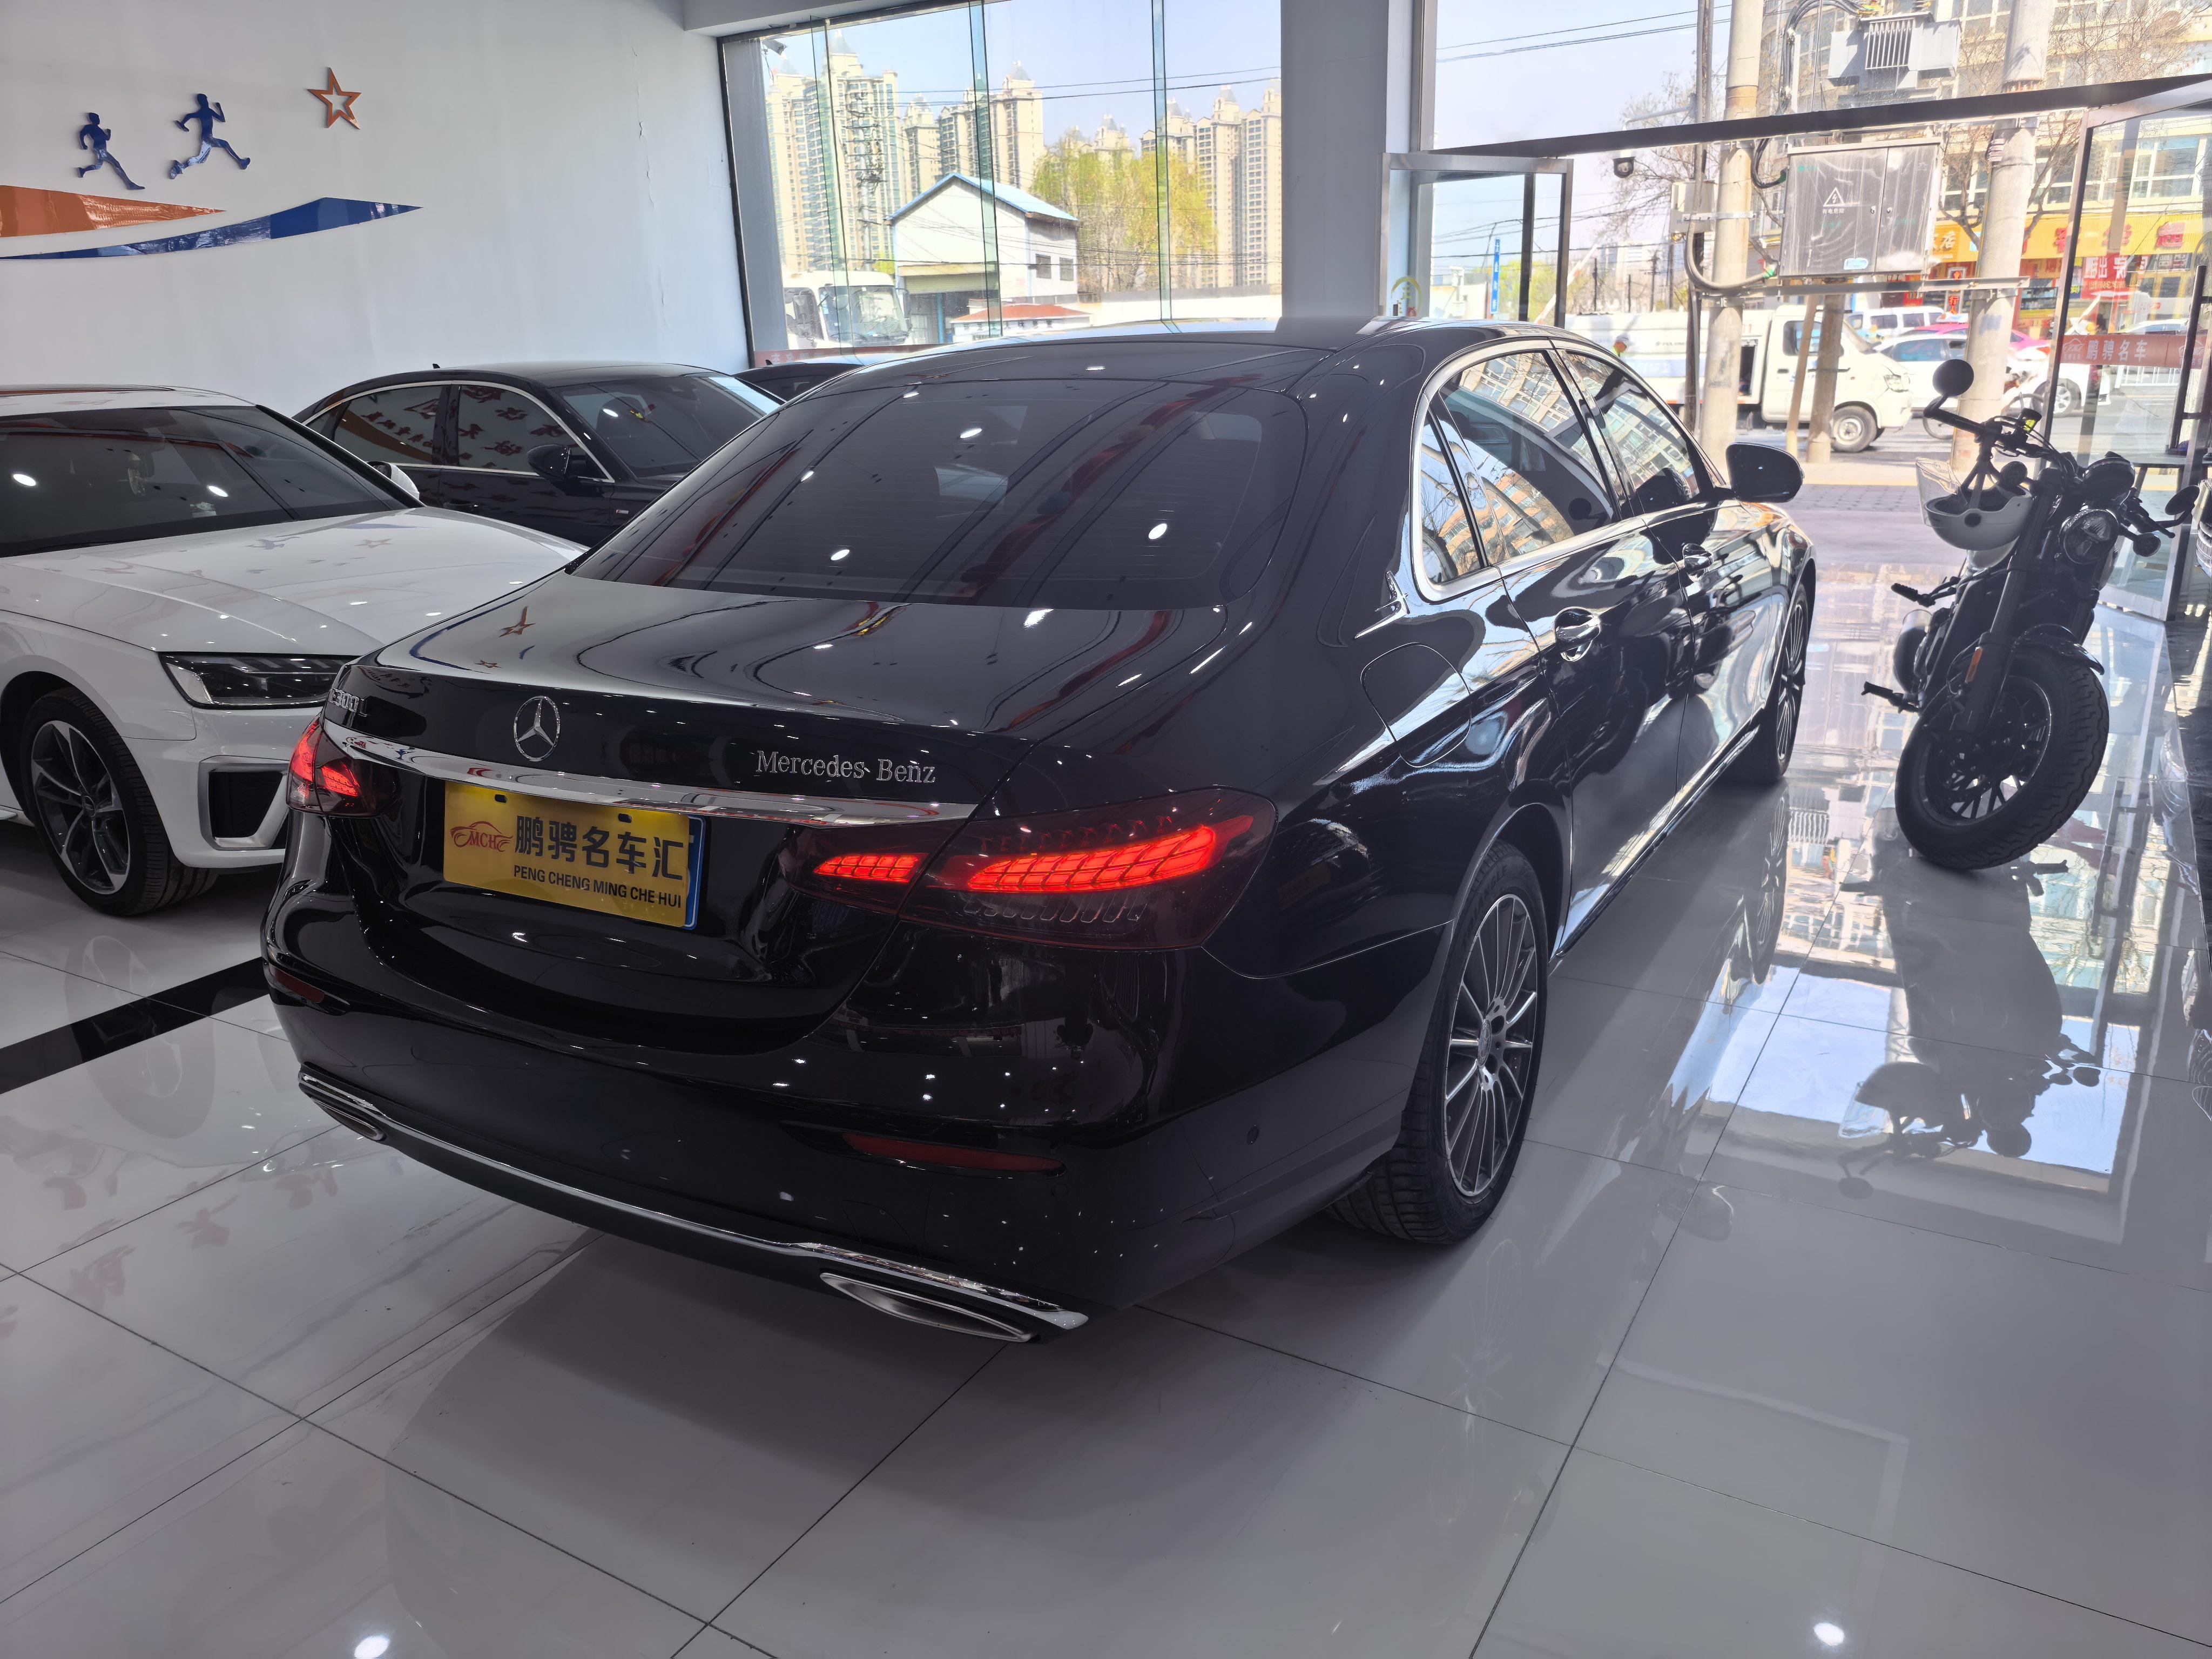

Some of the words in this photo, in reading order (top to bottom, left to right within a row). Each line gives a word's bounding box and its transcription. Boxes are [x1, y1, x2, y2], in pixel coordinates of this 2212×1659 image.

[756, 750, 865, 778] Mercedes
[875, 758, 936, 783] Benz
[515, 815, 684, 880] 鹏骋名车汇
[514, 864, 545, 882] PENG
[548, 871, 590, 891] CHENG
[593, 879, 627, 898] MING
[630, 886, 655, 903] CHE
[658, 893, 681, 908] HUI
